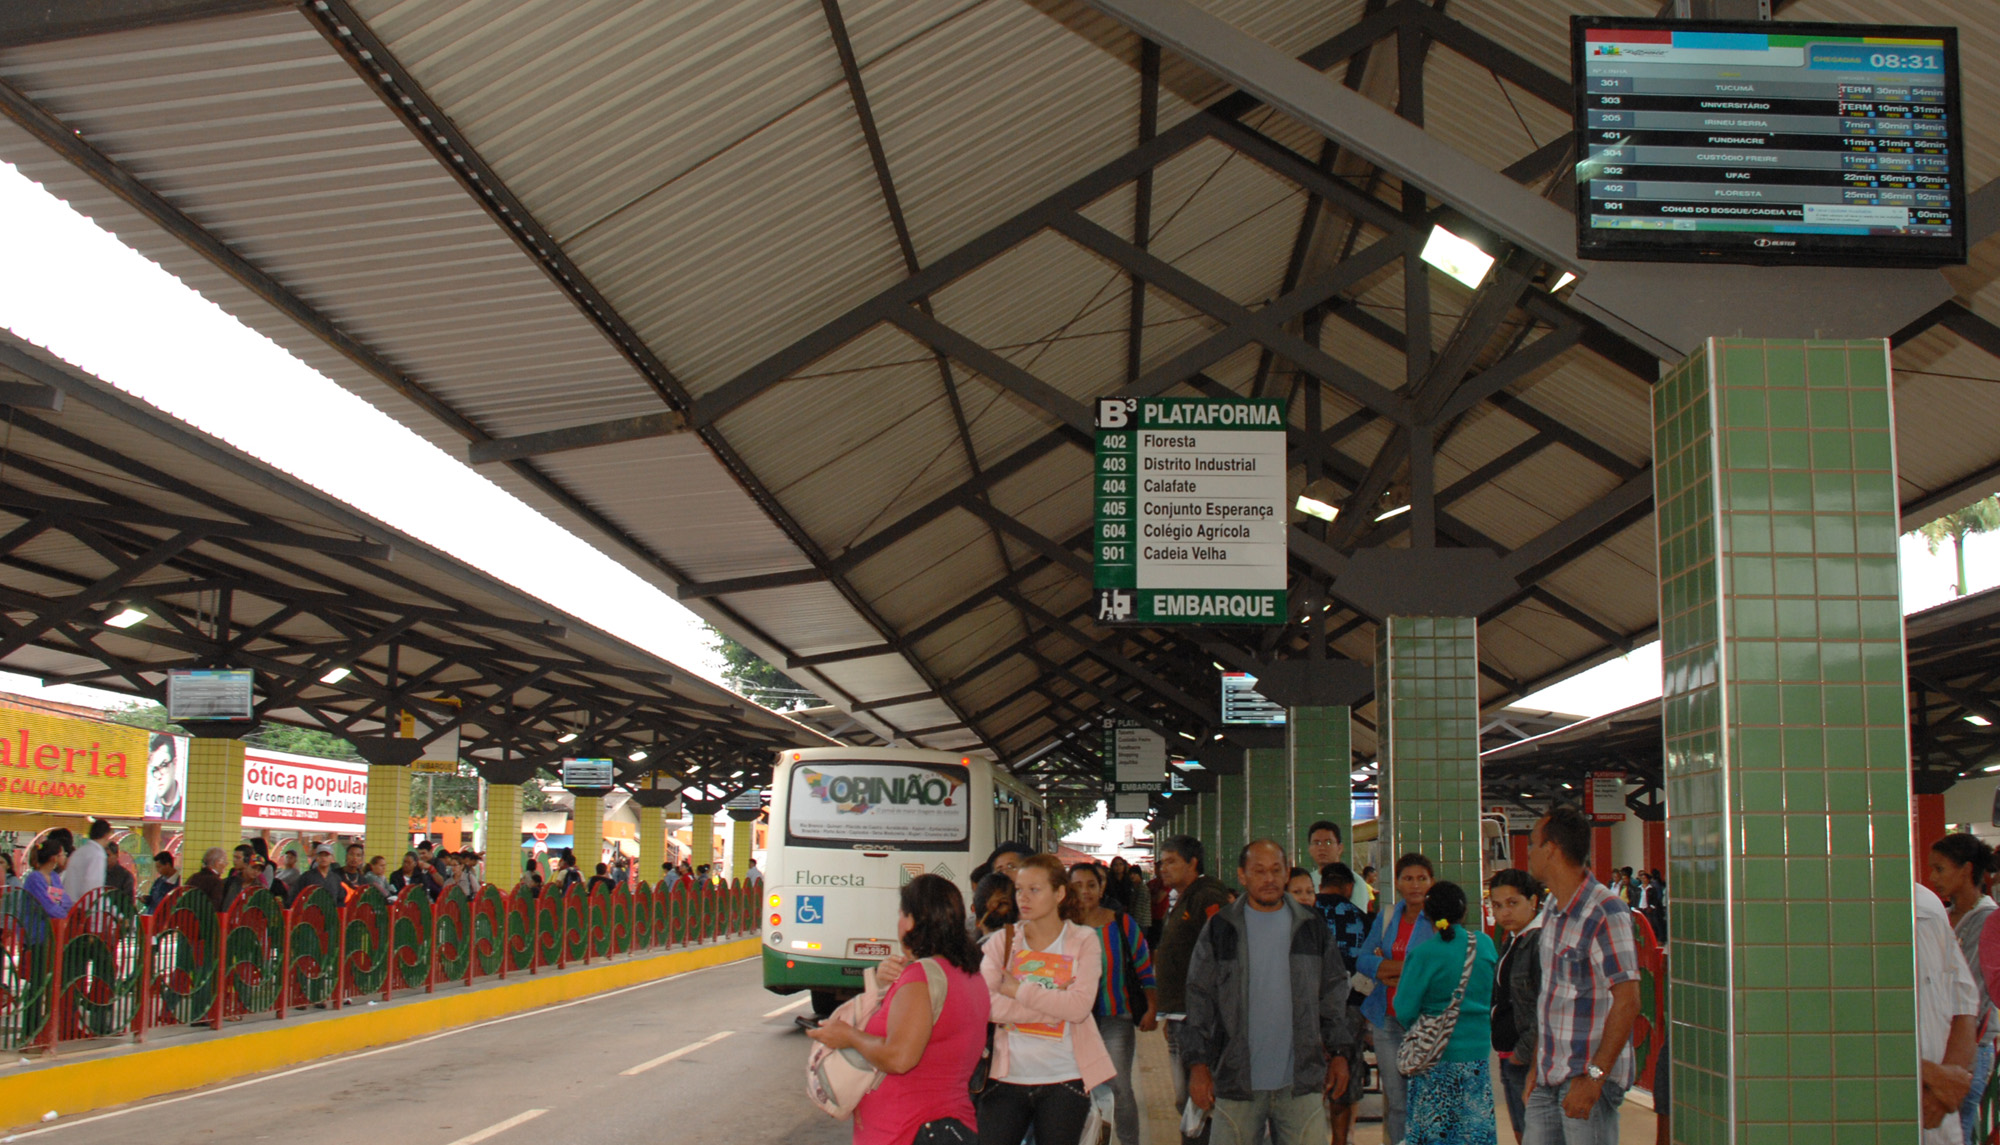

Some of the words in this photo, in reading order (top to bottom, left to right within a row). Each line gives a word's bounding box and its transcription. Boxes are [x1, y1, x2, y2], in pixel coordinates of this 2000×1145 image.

[1870, 53, 1938, 69] 08:31
[1601, 79, 1619, 87] 301
[1876, 87, 1908, 95] 30min
[1912, 88, 1943, 96] 54min
[1701, 101, 1770, 109] UNIVERSITÁRIO
[1842, 103, 1872, 111] TERM
[1878, 104, 1908, 112] 10min
[1913, 105, 1944, 114] 31min
[1878, 122, 1909, 130] 50min
[1913, 123, 1945, 131] 94min
[1914, 140, 1945, 148] 56min
[1603, 149, 1622, 157] 304
[1696, 153, 1743, 161] CUSTÓDIO
[1843, 173, 1875, 181] 22min
[1880, 174, 1912, 182] 56min
[1916, 175, 1947, 183] 92min
[1604, 184, 1623, 192] 402
[1881, 192, 1912, 200] 56min
[1916, 193, 1948, 201] 92min
[1604, 202, 1623, 210] 901
[1711, 207, 1786, 215] BOSQUE/CADEIA
[1917, 210, 1949, 218] 60min
[1144, 404, 1281, 425] PLATAFORMA
[1102, 435, 1126, 449] 402
[1144, 434, 1196, 448] Floresta
[1102, 457, 1126, 471] 403
[1144, 457, 1191, 471] Distrito
[1195, 458, 1256, 472] Industrial
[1102, 479, 1126, 493] 404
[1144, 479, 1197, 493] Calafate
[1102, 502, 1126, 515] 405
[1144, 502, 1202, 518] Conjunto
[1206, 503, 1273, 521] Esperança
[1102, 524, 1126, 538] 604
[1144, 523, 1193, 540] Colégio
[1197, 523, 1250, 540] Agrícola
[1102, 546, 1126, 560] 901
[1144, 546, 1188, 560] Cadeia
[1192, 547, 1227, 560] Velha
[1153, 595, 1275, 617] EMBARQUE
[247, 762, 298, 790] ótica
[10, 778, 86, 799] CALÇADOS
[829, 773, 959, 807] OPINIÃO!
[1121, 783, 1161, 791] EMBARQUE
[246, 789, 263, 801] Ver
[265, 794, 285, 803] com
[796, 870, 864, 886] Floresta
